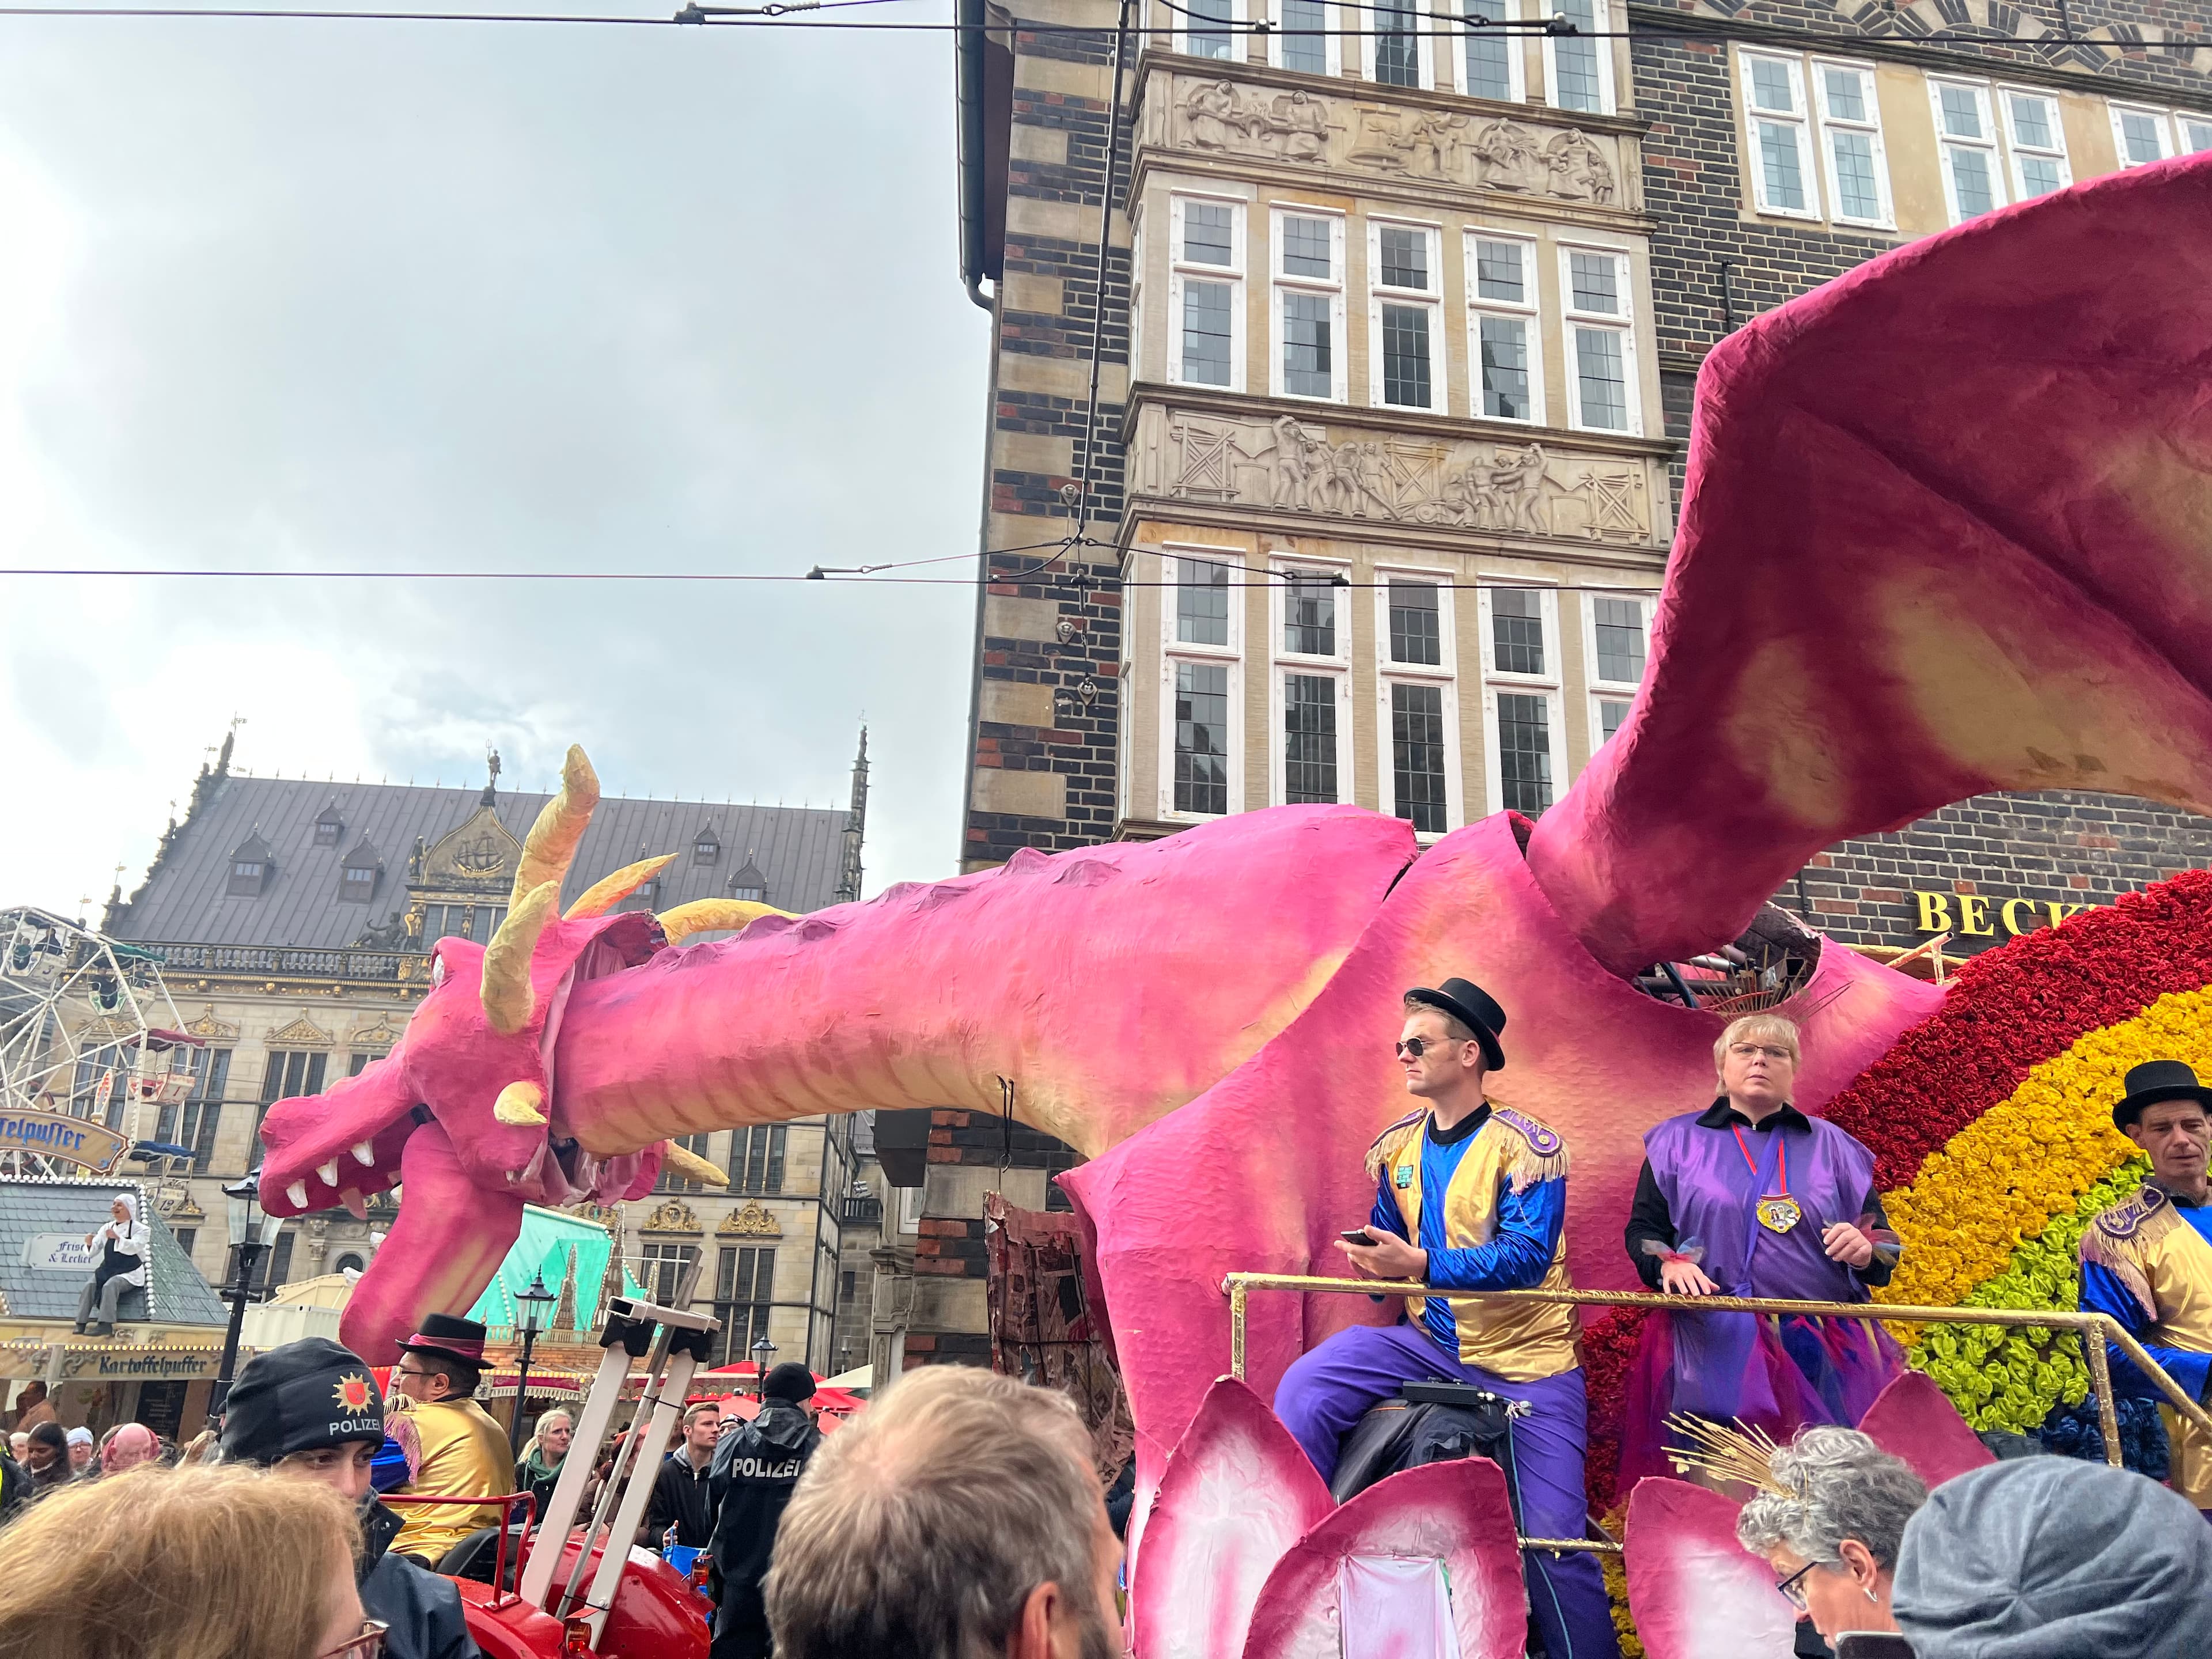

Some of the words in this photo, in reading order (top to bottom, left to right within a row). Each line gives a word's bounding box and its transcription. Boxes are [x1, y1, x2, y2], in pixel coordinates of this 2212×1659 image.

[159, 1200, 175, 1211] 12
[61, 1253, 92, 1263] Lecker
[99, 1355, 207, 1377] Kartoffelpuffer
[329, 1418, 381, 1435] POLIZEI
[732, 1457, 801, 1478] POLIZEI
